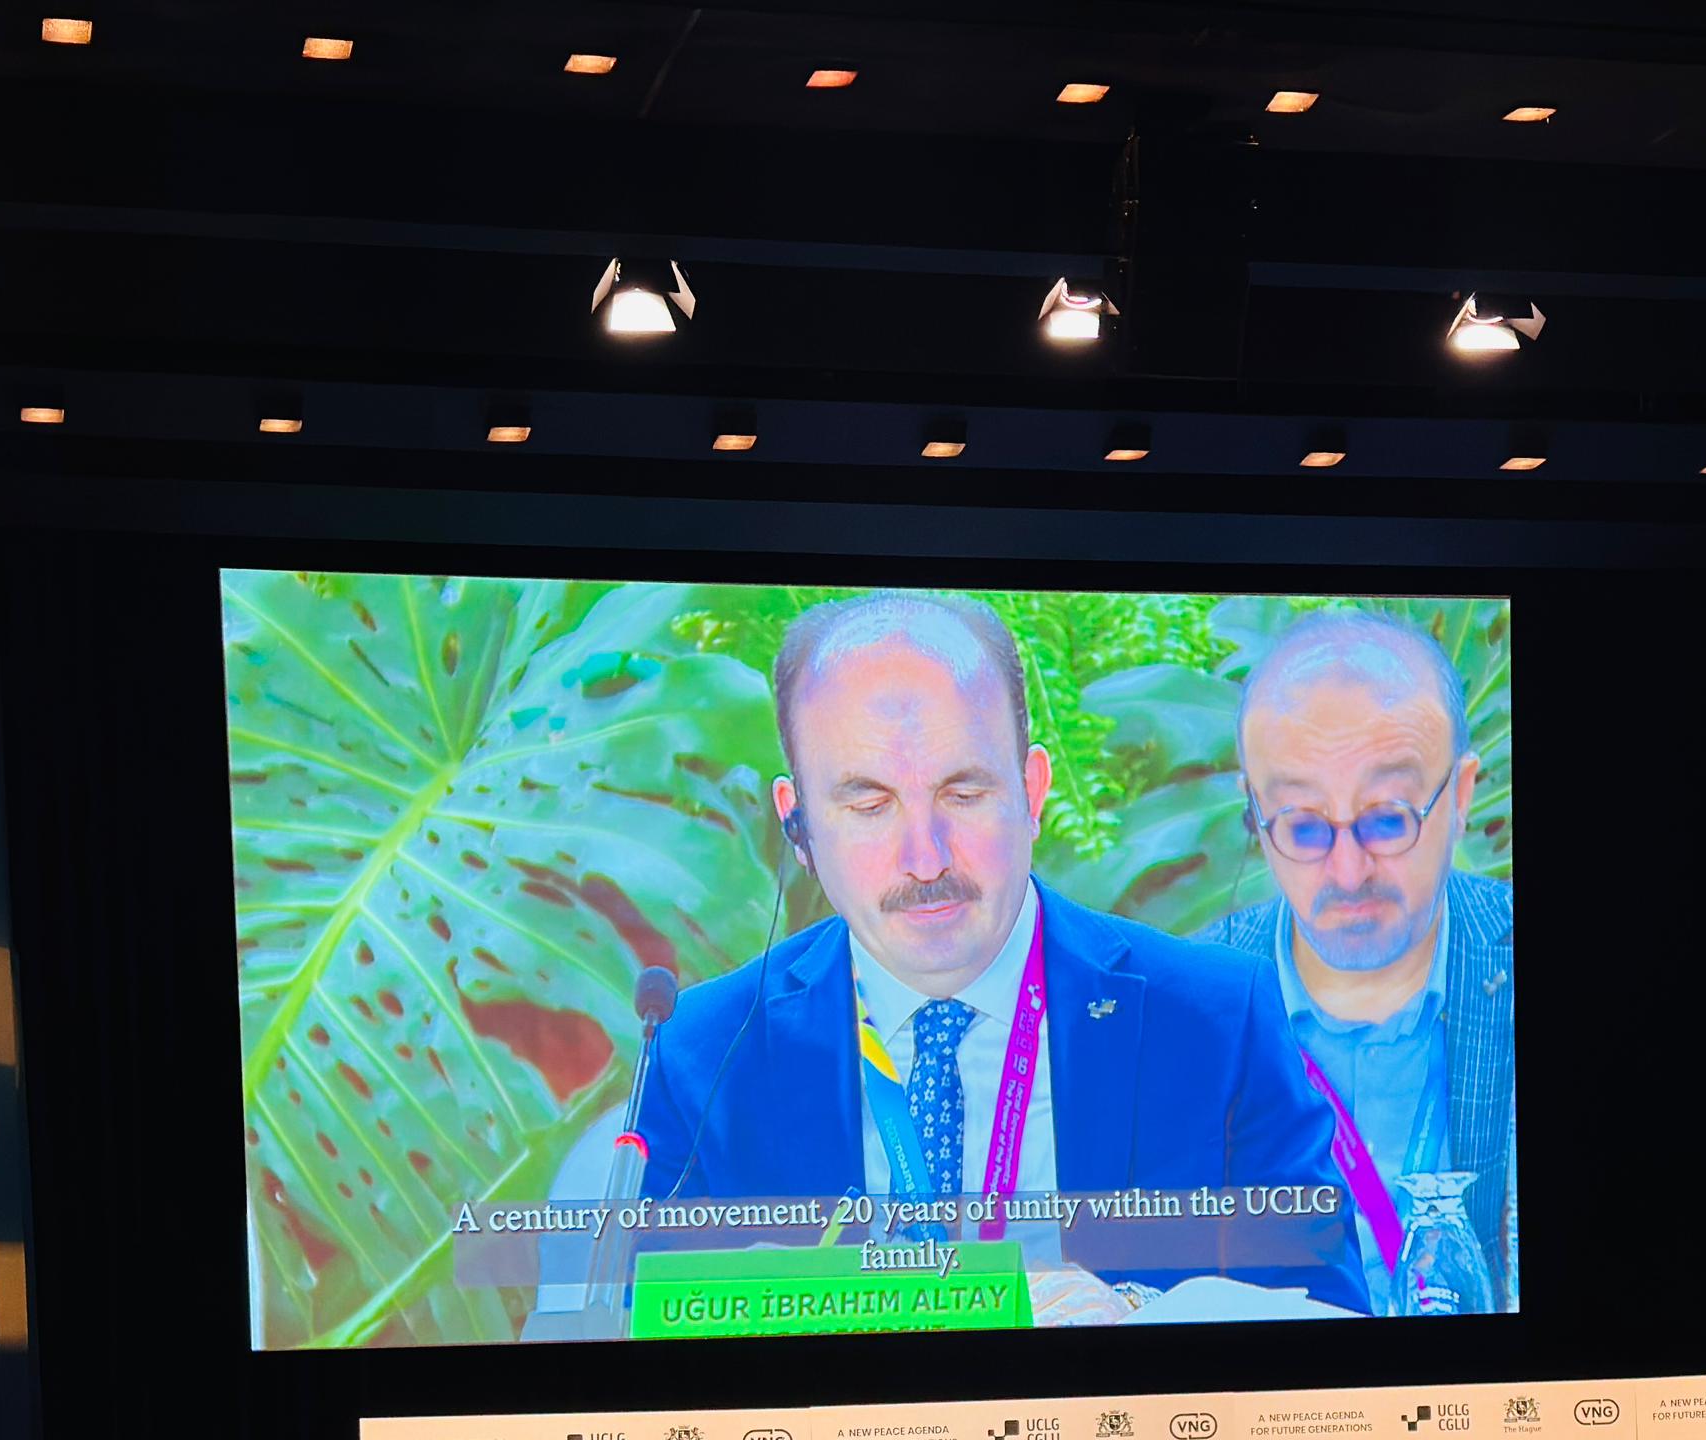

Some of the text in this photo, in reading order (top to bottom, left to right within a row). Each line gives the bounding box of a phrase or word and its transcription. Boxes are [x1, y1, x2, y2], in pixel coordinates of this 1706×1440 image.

[453, 1185, 1337, 1239] A century of movement, 20 years of unity within the UCLG
[860, 1237, 960, 1279] family.
[662, 1290, 750, 1323] UĞUR
[911, 1284, 1007, 1312] ALTAY
[1438, 1404, 1469, 1417] UCLG
[1581, 1406, 1613, 1418] VNG
[1027, 1418, 1060, 1431] UCLG
[1177, 1421, 1210, 1433] VNG
[1438, 1418, 1470, 1431] CGLU
